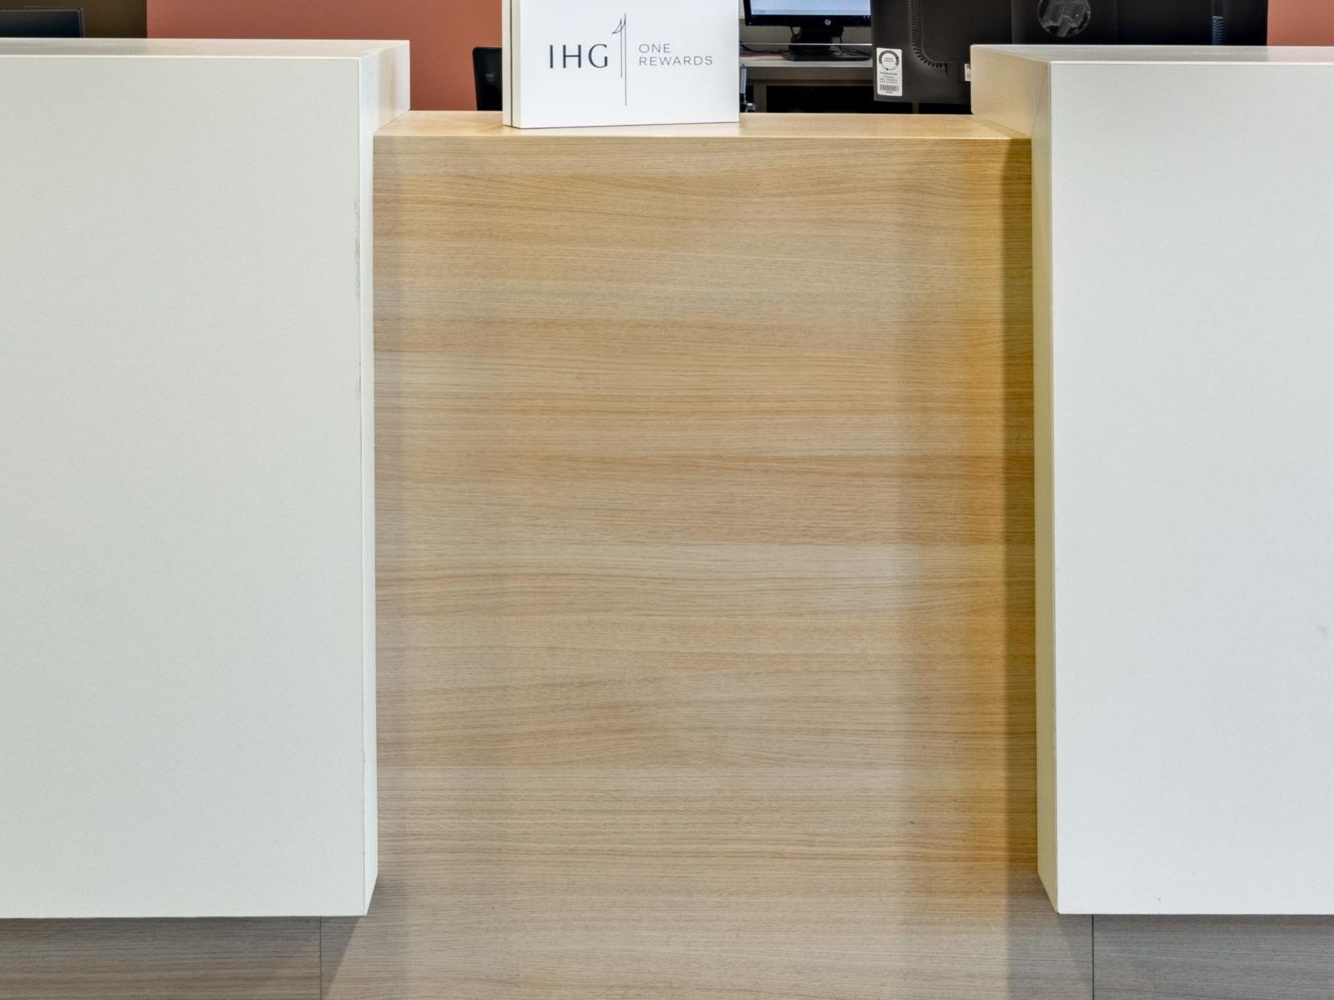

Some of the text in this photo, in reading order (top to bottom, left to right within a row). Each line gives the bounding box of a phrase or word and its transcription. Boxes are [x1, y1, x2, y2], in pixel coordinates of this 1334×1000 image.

[638, 43, 671, 54] ONE
[549, 43, 609, 69] IHG
[638, 55, 713, 67] REWARDS
